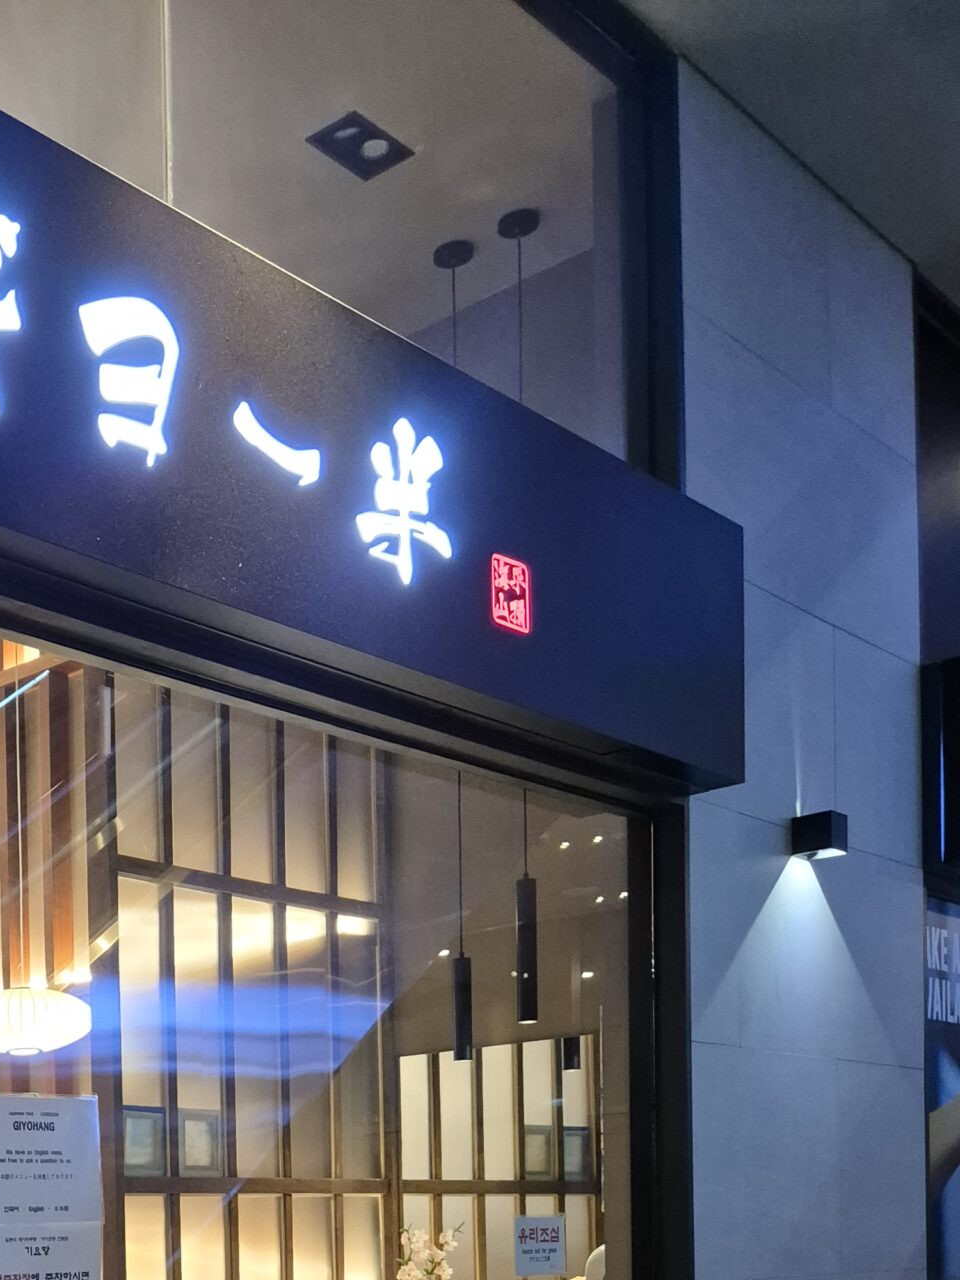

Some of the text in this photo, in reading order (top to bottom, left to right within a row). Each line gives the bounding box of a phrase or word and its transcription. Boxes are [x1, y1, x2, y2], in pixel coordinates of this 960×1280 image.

[12, 1120, 55, 1132] GIYOHANG
[518, 1226, 560, 1245] 유리조심
[24, 1246, 50, 1256] 기요항
